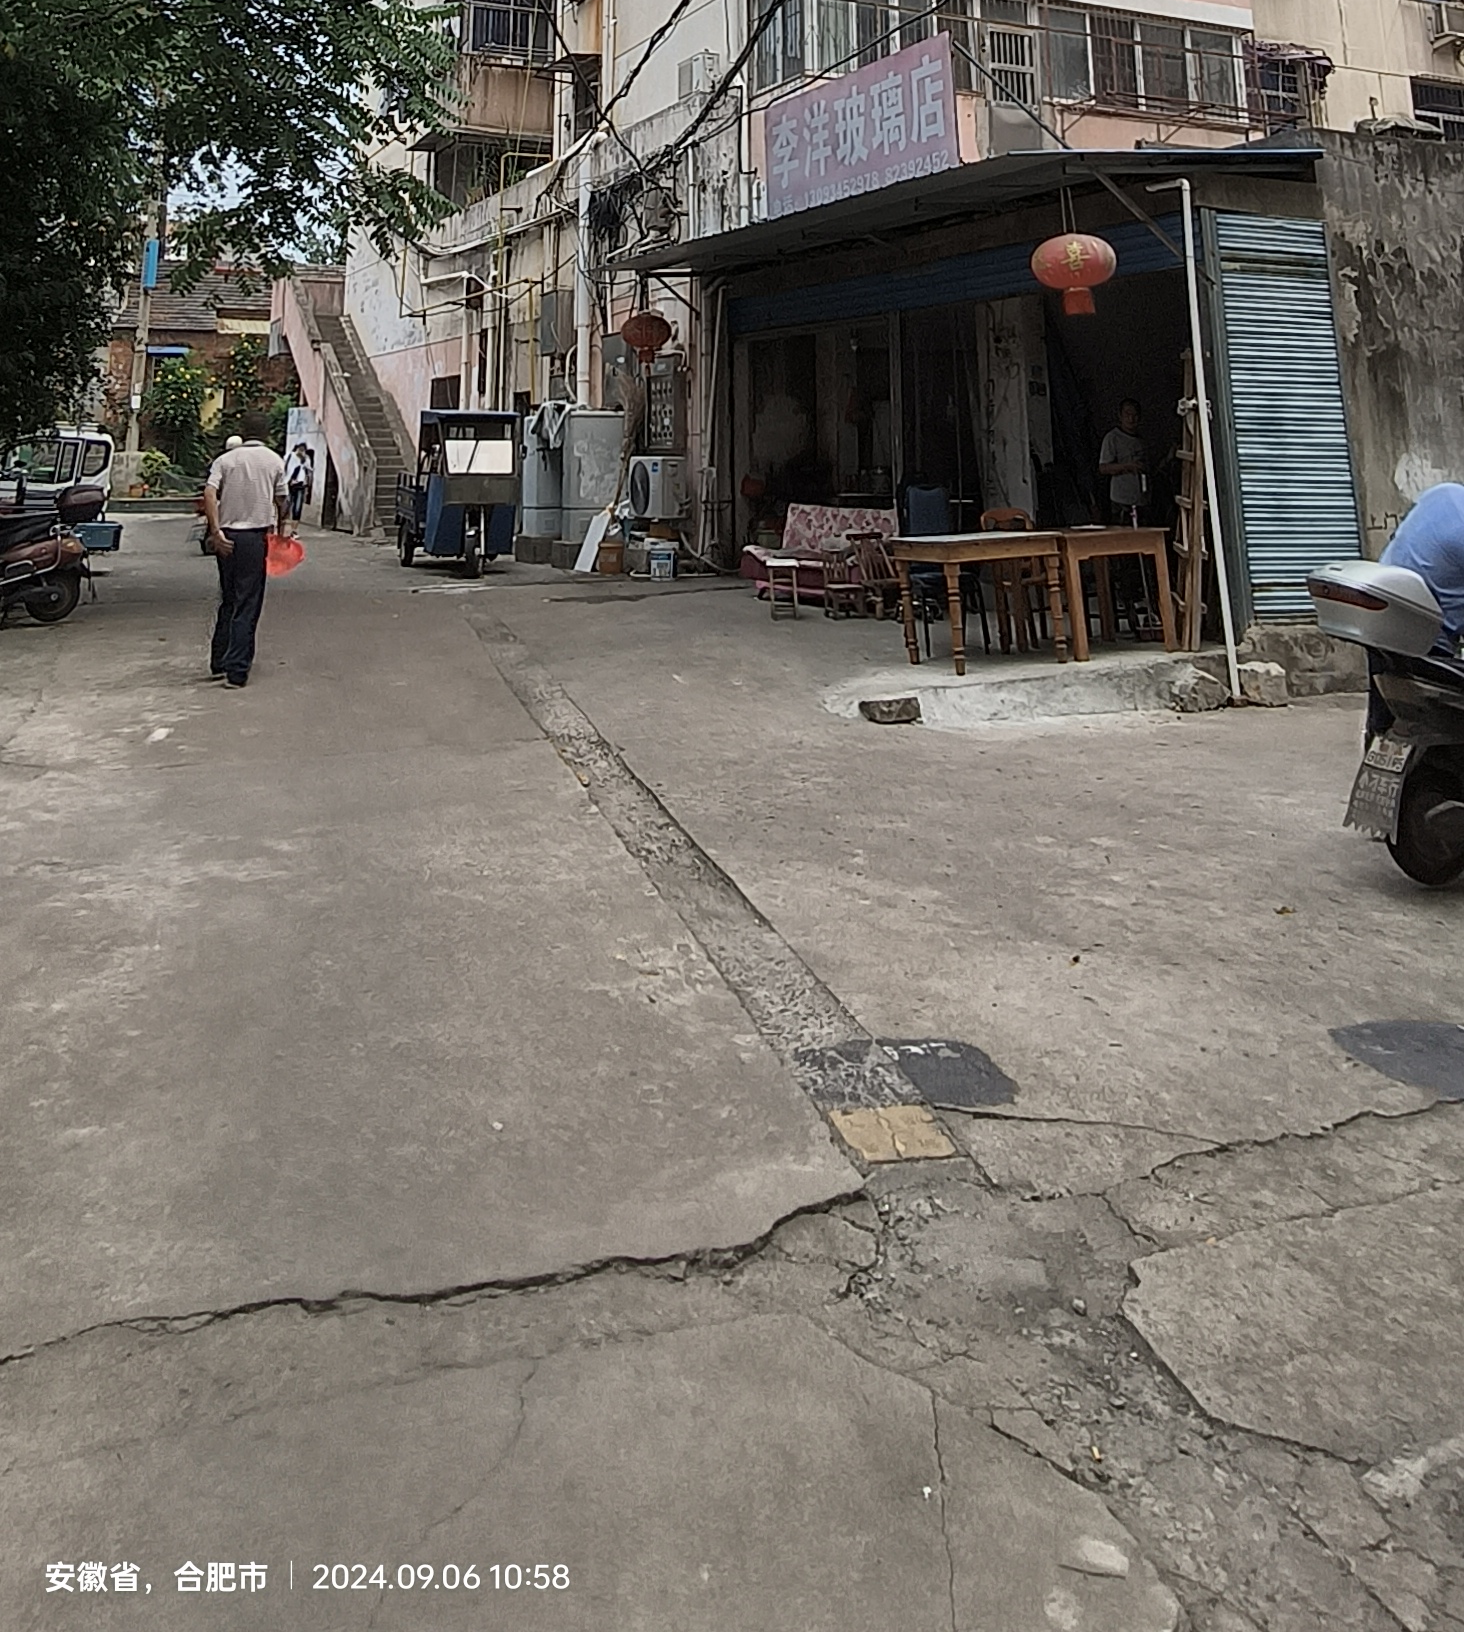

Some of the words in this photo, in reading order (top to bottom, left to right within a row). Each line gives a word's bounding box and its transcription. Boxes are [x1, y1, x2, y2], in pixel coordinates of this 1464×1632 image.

[771, 54, 946, 189] 李洋玻璃店
[884, 150, 949, 184] 82392452
